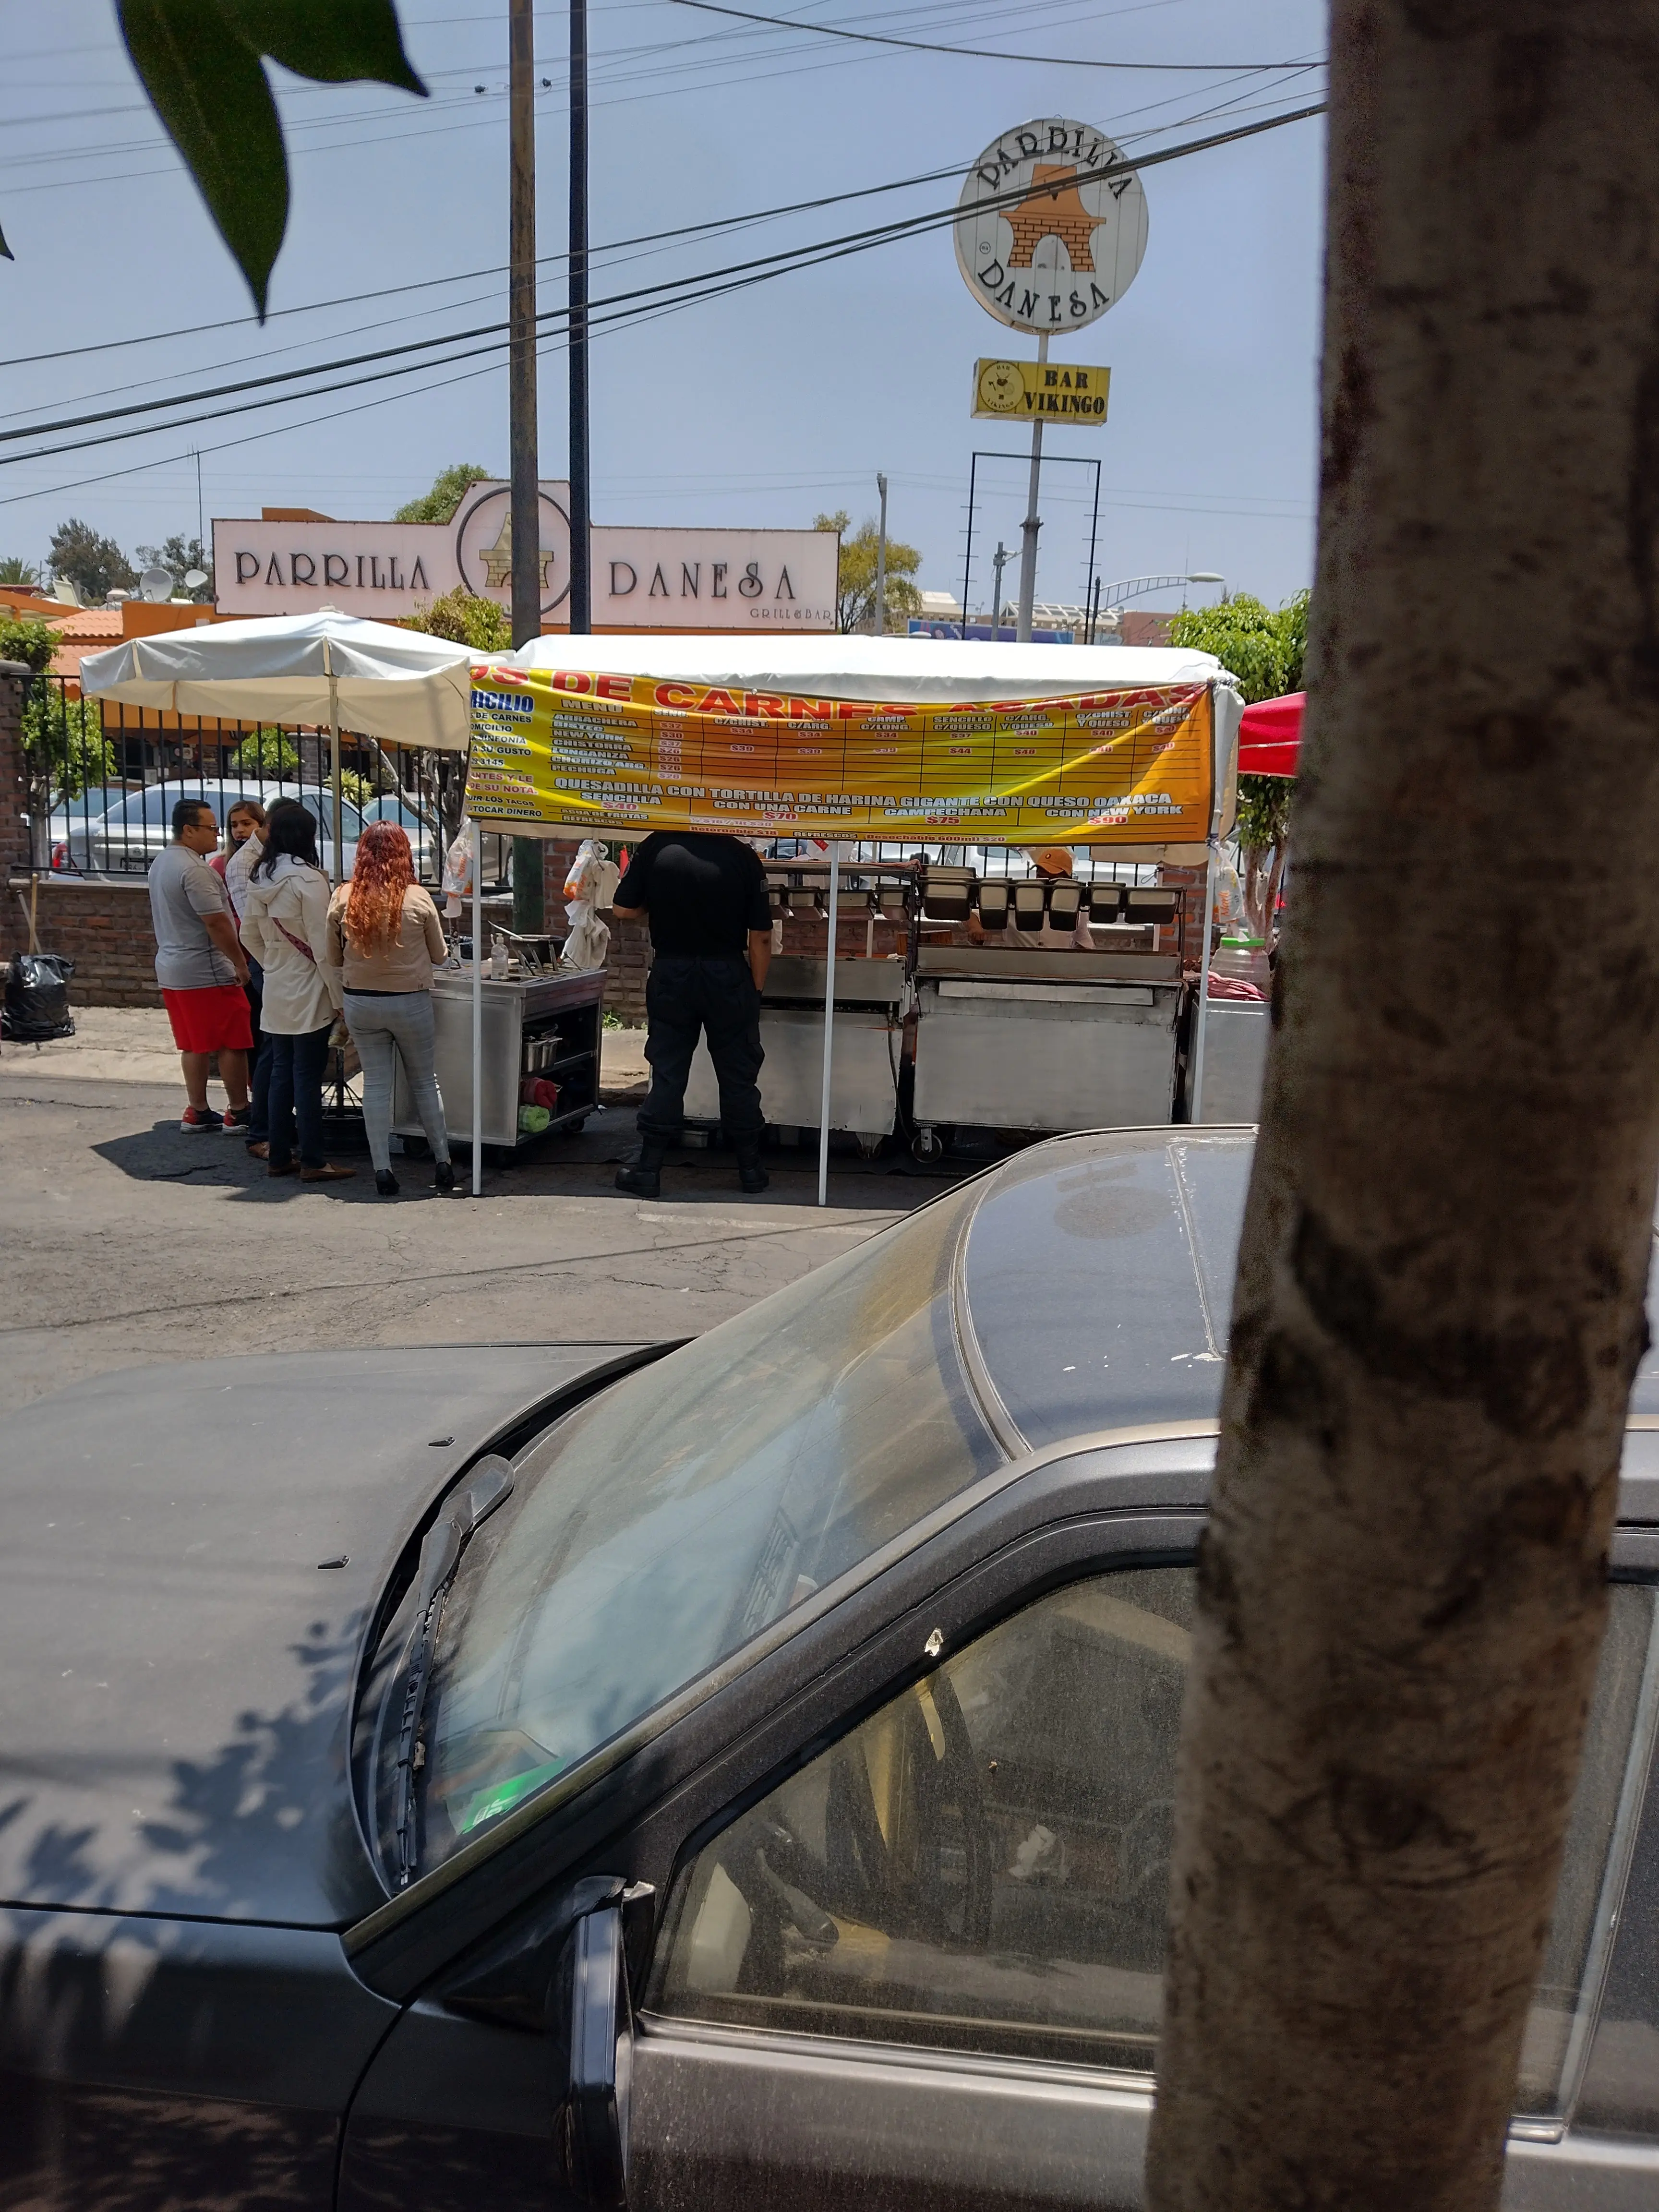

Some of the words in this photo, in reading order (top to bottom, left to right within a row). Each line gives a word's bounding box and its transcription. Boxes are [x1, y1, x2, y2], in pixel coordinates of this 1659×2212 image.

[978, 258, 1109, 322] DANESA
[1044, 370, 1088, 389] BAR
[1023, 391, 1105, 414] VIKINGO
[234, 551, 431, 590] PARRILLA
[608, 561, 796, 599] DANESA
[551, 671, 634, 703] DE
[654, 682, 919, 720] CARNES
[491, 713, 532, 723] CARNES
[553, 713, 638, 727] ARRACHERA
[714, 717, 769, 727] C/CHIST.
[553, 721, 604, 732] BISTEC
[787, 721, 833, 730] C/ARG.
[1011, 722, 1054, 730] QUESO
[1088, 720, 1130, 728] QUESO
[553, 729, 584, 739] NEW
[586, 733, 625, 742] YORK
[661, 731, 683, 739] $30
[552, 739, 633, 751] CHISTORRA
[497, 747, 531, 756] GUSTO
[552, 747, 629, 760] LONGANIZA
[480, 758, 504, 766] 3145
[551, 756, 613, 766] CHORIZO
[551, 764, 617, 776] PECHUGA
[504, 785, 538, 793] NOTA.
[554, 777, 663, 795] QUESADILLA
[667, 785, 706, 798] CON
[709, 788, 794, 804] TORTILLA
[799, 793, 822, 804] DE
[826, 794, 897, 806] HARINA
[900, 796, 980, 807] GIGANTE
[984, 795, 1023, 806] CON
[1027, 796, 1090, 807] QUESO
[1094, 793, 1172, 807] OAXACA
[505, 798, 534, 806] TACOS
[580, 792, 662, 805] SENCILLA
[473, 805, 504, 814] TOCAR
[506, 808, 542, 817] DINERO
[601, 802, 638, 810] $40
[713, 800, 750, 810] CON
[754, 803, 791, 812] UNA
[793, 804, 852, 815] CARNE
[1046, 808, 1084, 817] CON
[1087, 806, 1130, 817] NEW
[1133, 805, 1184, 815] YORK
[764, 812, 796, 820] $70
[884, 807, 1007, 817] CAMPECHANA
[562, 815, 624, 825] REFRESCOS
[926, 816, 960, 824] $75
[1088, 816, 1127, 824] $90
[691, 826, 754, 835] Retornable
[793, 830, 858, 839] REFRESCOS
